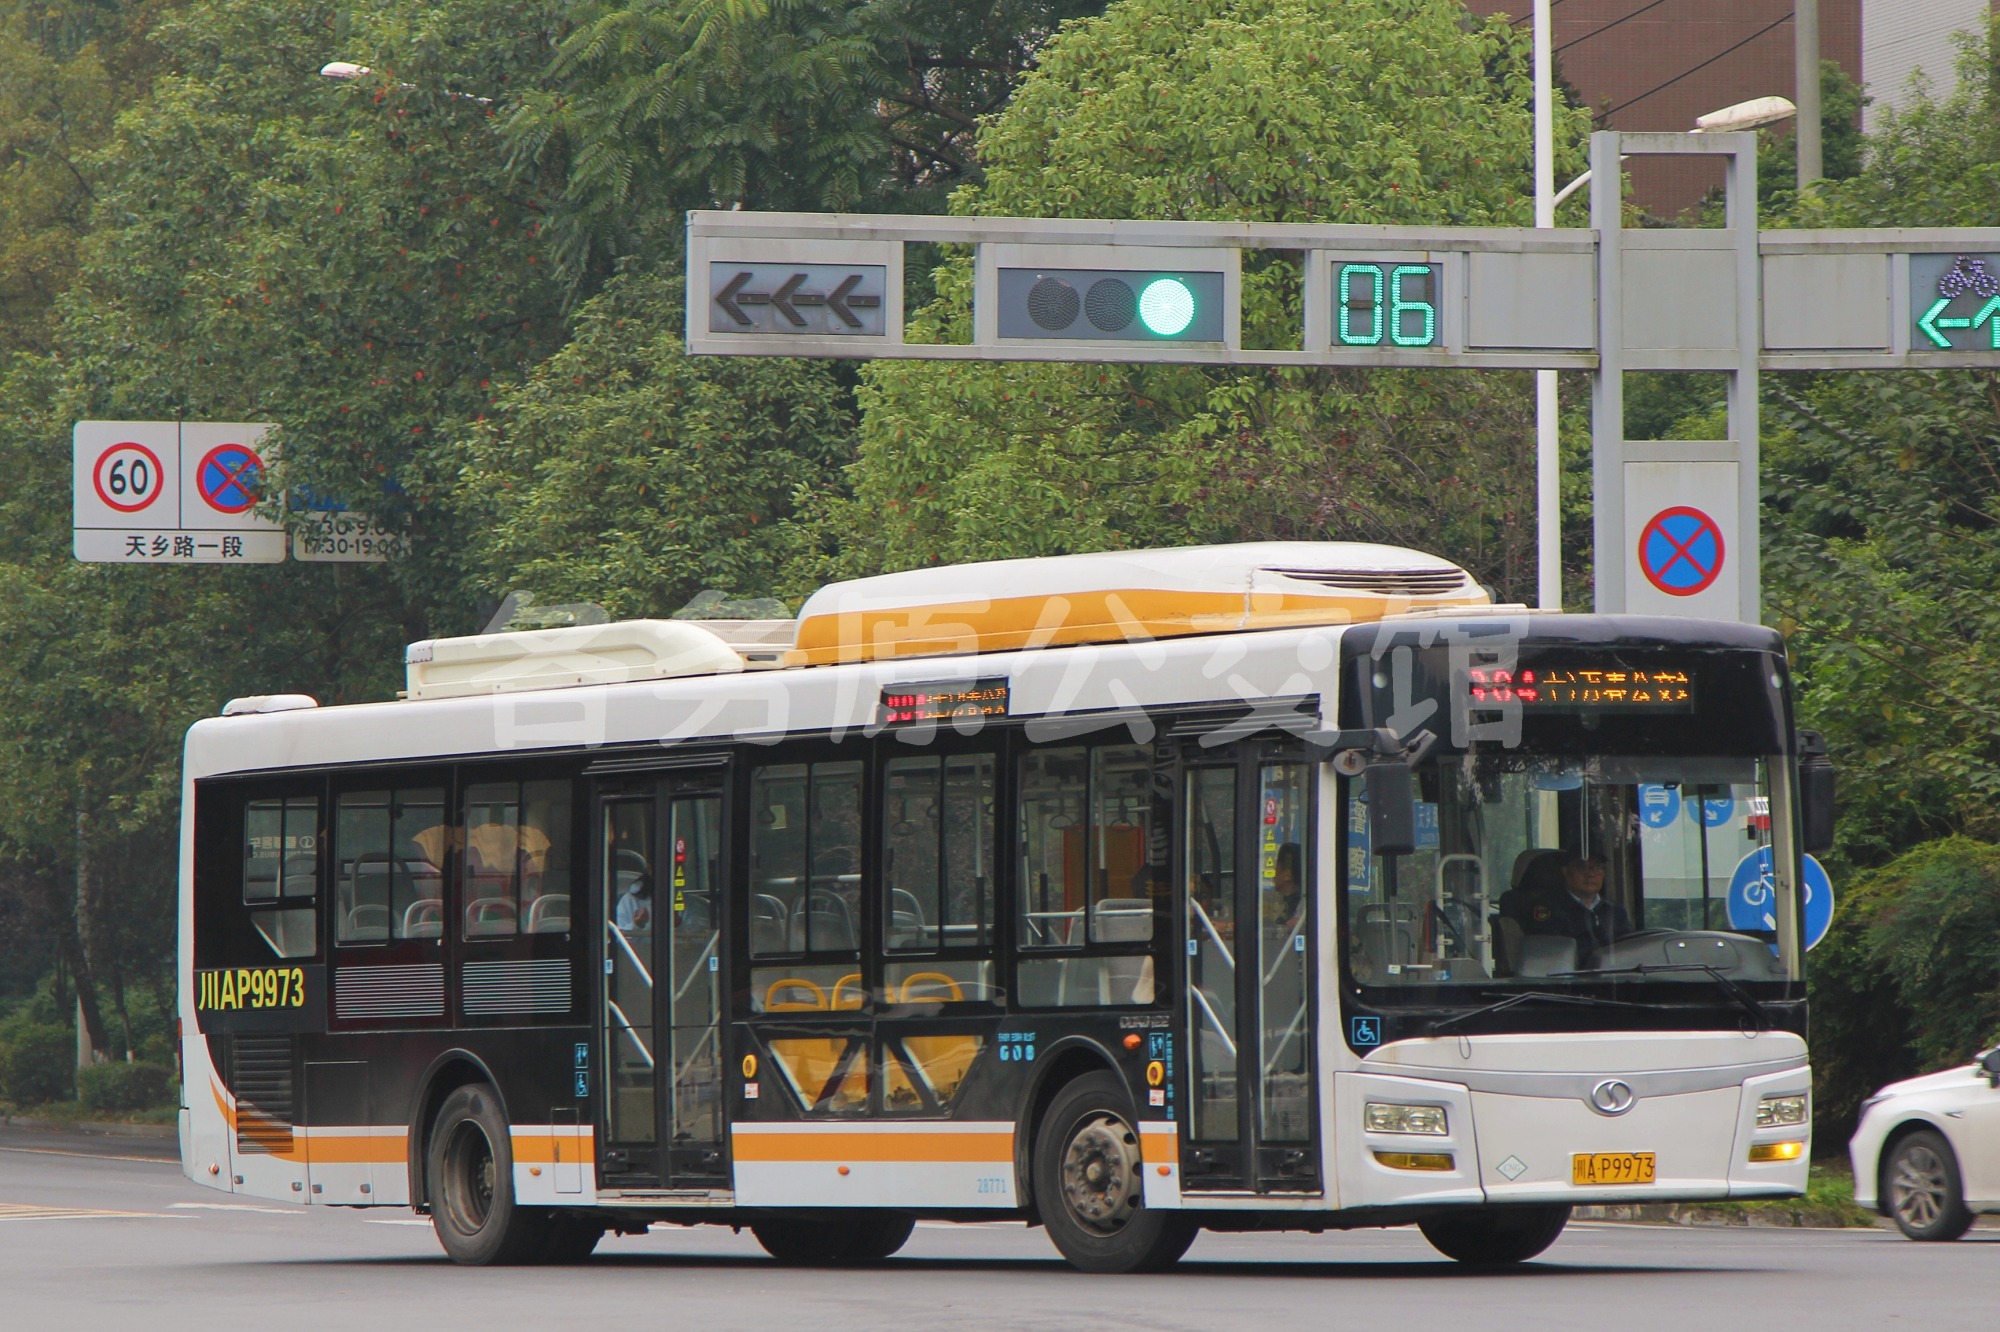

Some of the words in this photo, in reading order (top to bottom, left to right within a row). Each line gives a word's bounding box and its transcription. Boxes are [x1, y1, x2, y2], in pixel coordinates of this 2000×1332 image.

[1340, 264, 1434, 346] 06
[109, 459, 148, 495] 60
[125, 535, 243, 558] 天乡路一段
[199, 967, 305, 1010] 川AP9973
[977, 1178, 1007, 1193] 28771
